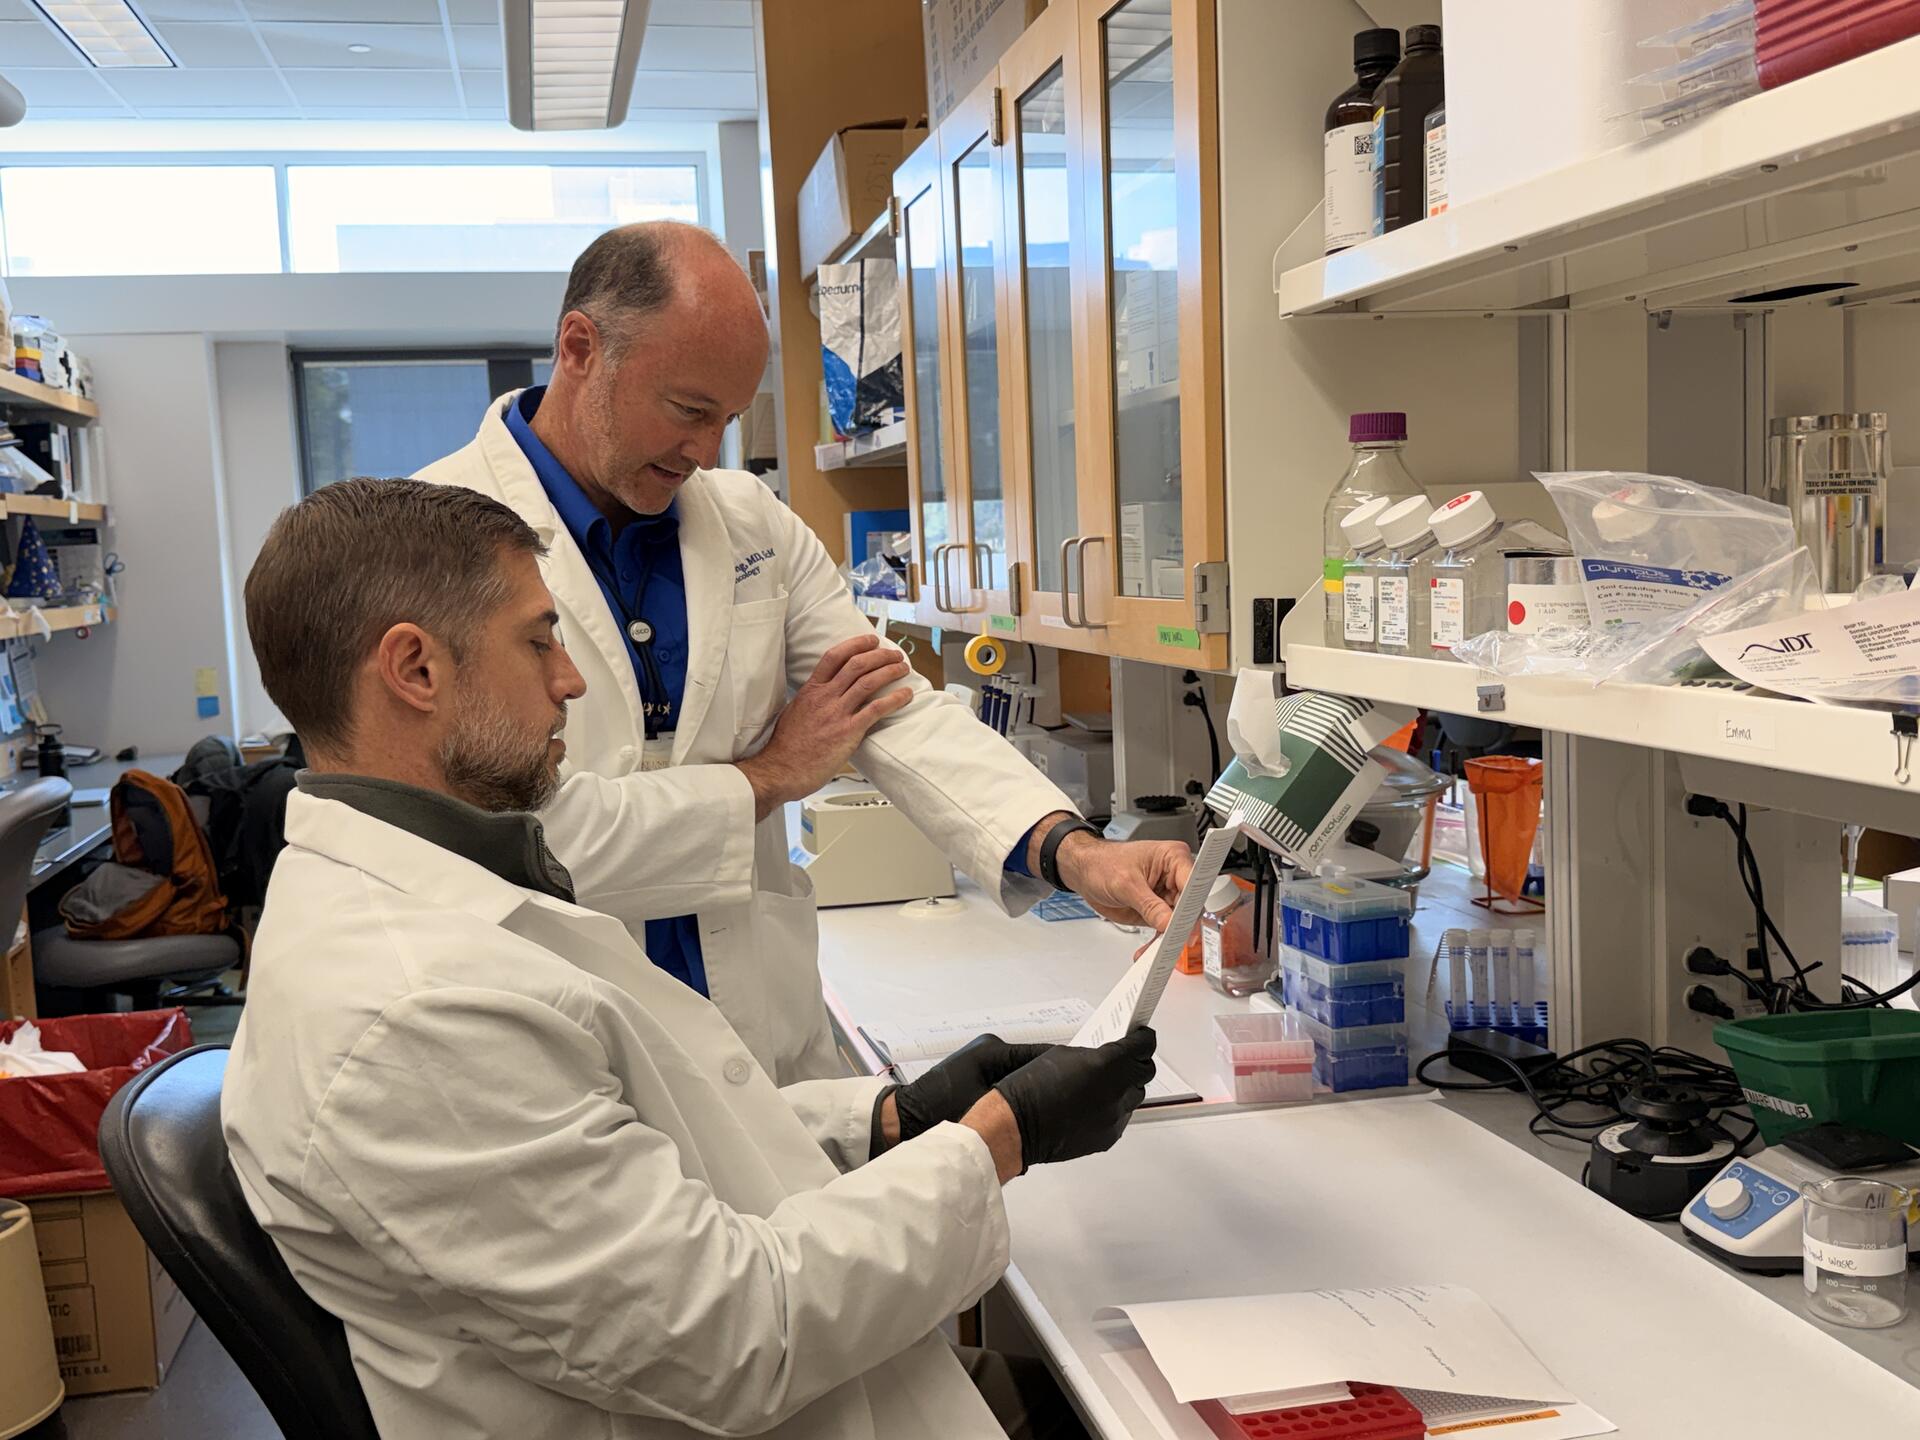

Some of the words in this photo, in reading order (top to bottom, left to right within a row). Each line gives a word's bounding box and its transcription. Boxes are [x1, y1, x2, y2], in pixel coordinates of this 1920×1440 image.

[1725, 719, 1752, 741] Emma
[1828, 1256, 1858, 1271] waste
[1826, 1278, 1839, 1288] 100
[1863, 1284, 1877, 1292] 100
